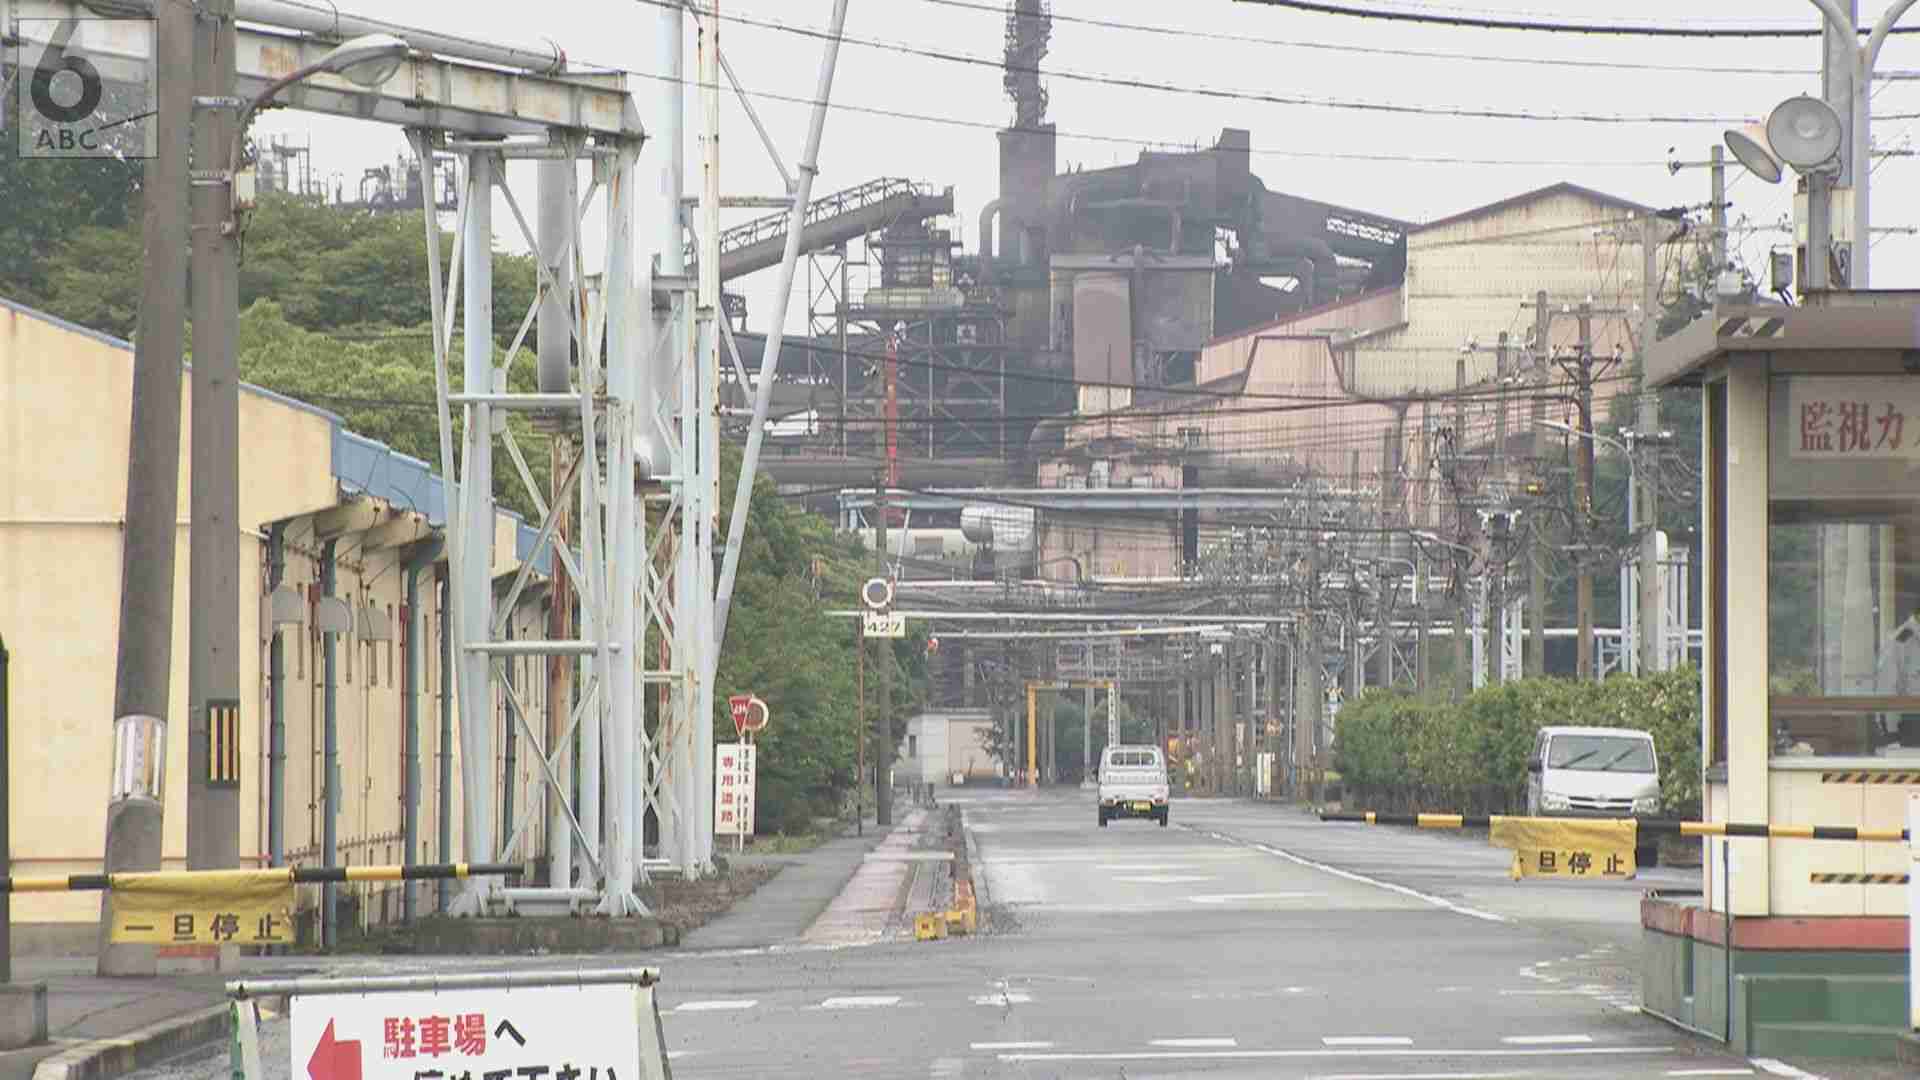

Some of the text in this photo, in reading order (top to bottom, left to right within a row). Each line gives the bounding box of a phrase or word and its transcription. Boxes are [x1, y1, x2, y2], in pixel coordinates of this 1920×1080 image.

[1800, 400, 1920, 452] 監視カ
[1519, 849, 1626, 875] 旦停止
[125, 912, 282, 941] 一旦停止
[383, 1013, 527, 1060] 駐車場へ
